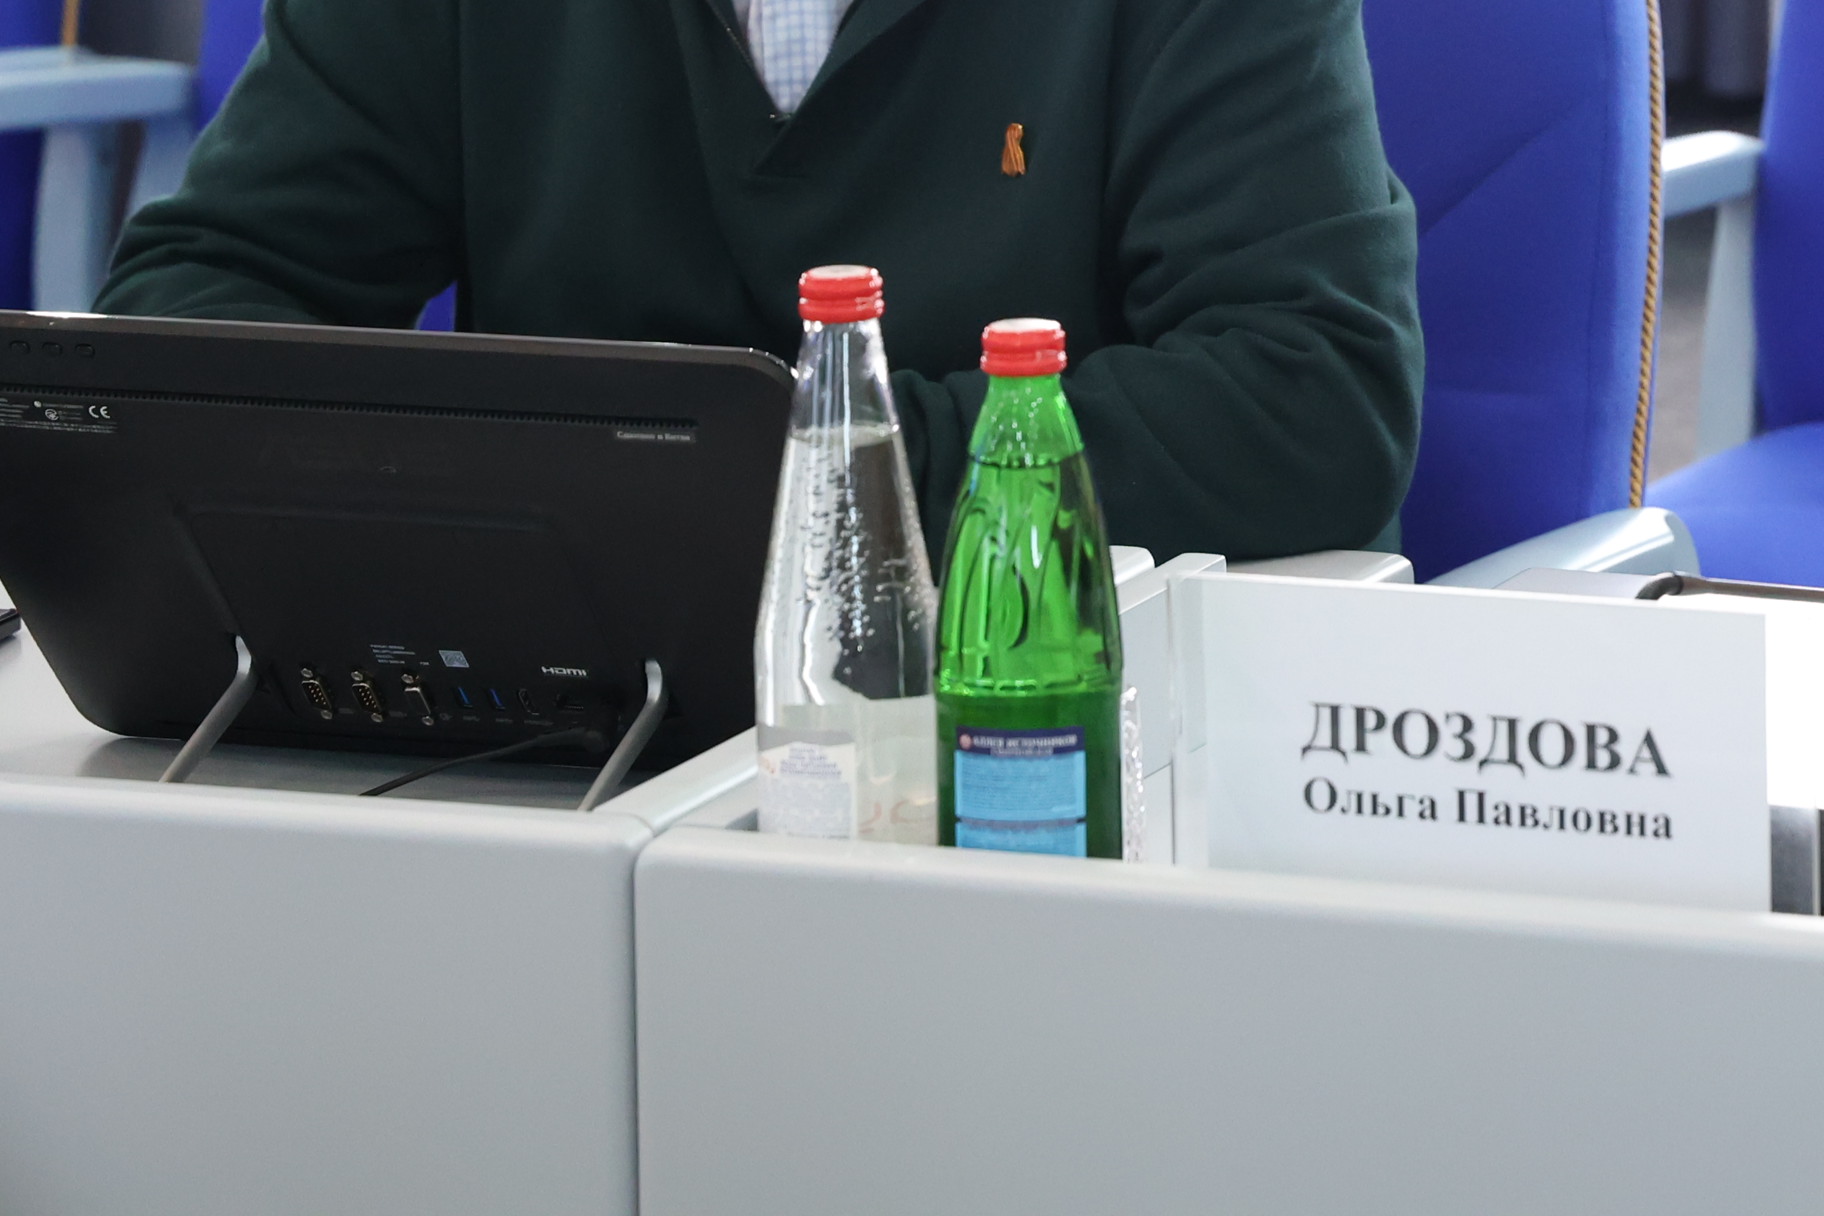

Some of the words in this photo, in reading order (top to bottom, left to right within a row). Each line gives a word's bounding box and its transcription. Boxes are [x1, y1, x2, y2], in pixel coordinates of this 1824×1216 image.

[1301, 701, 1672, 778] ДРОЗДОВА
[1303, 777, 1438, 822] Ольга
[1454, 788, 1673, 840] Павловна
